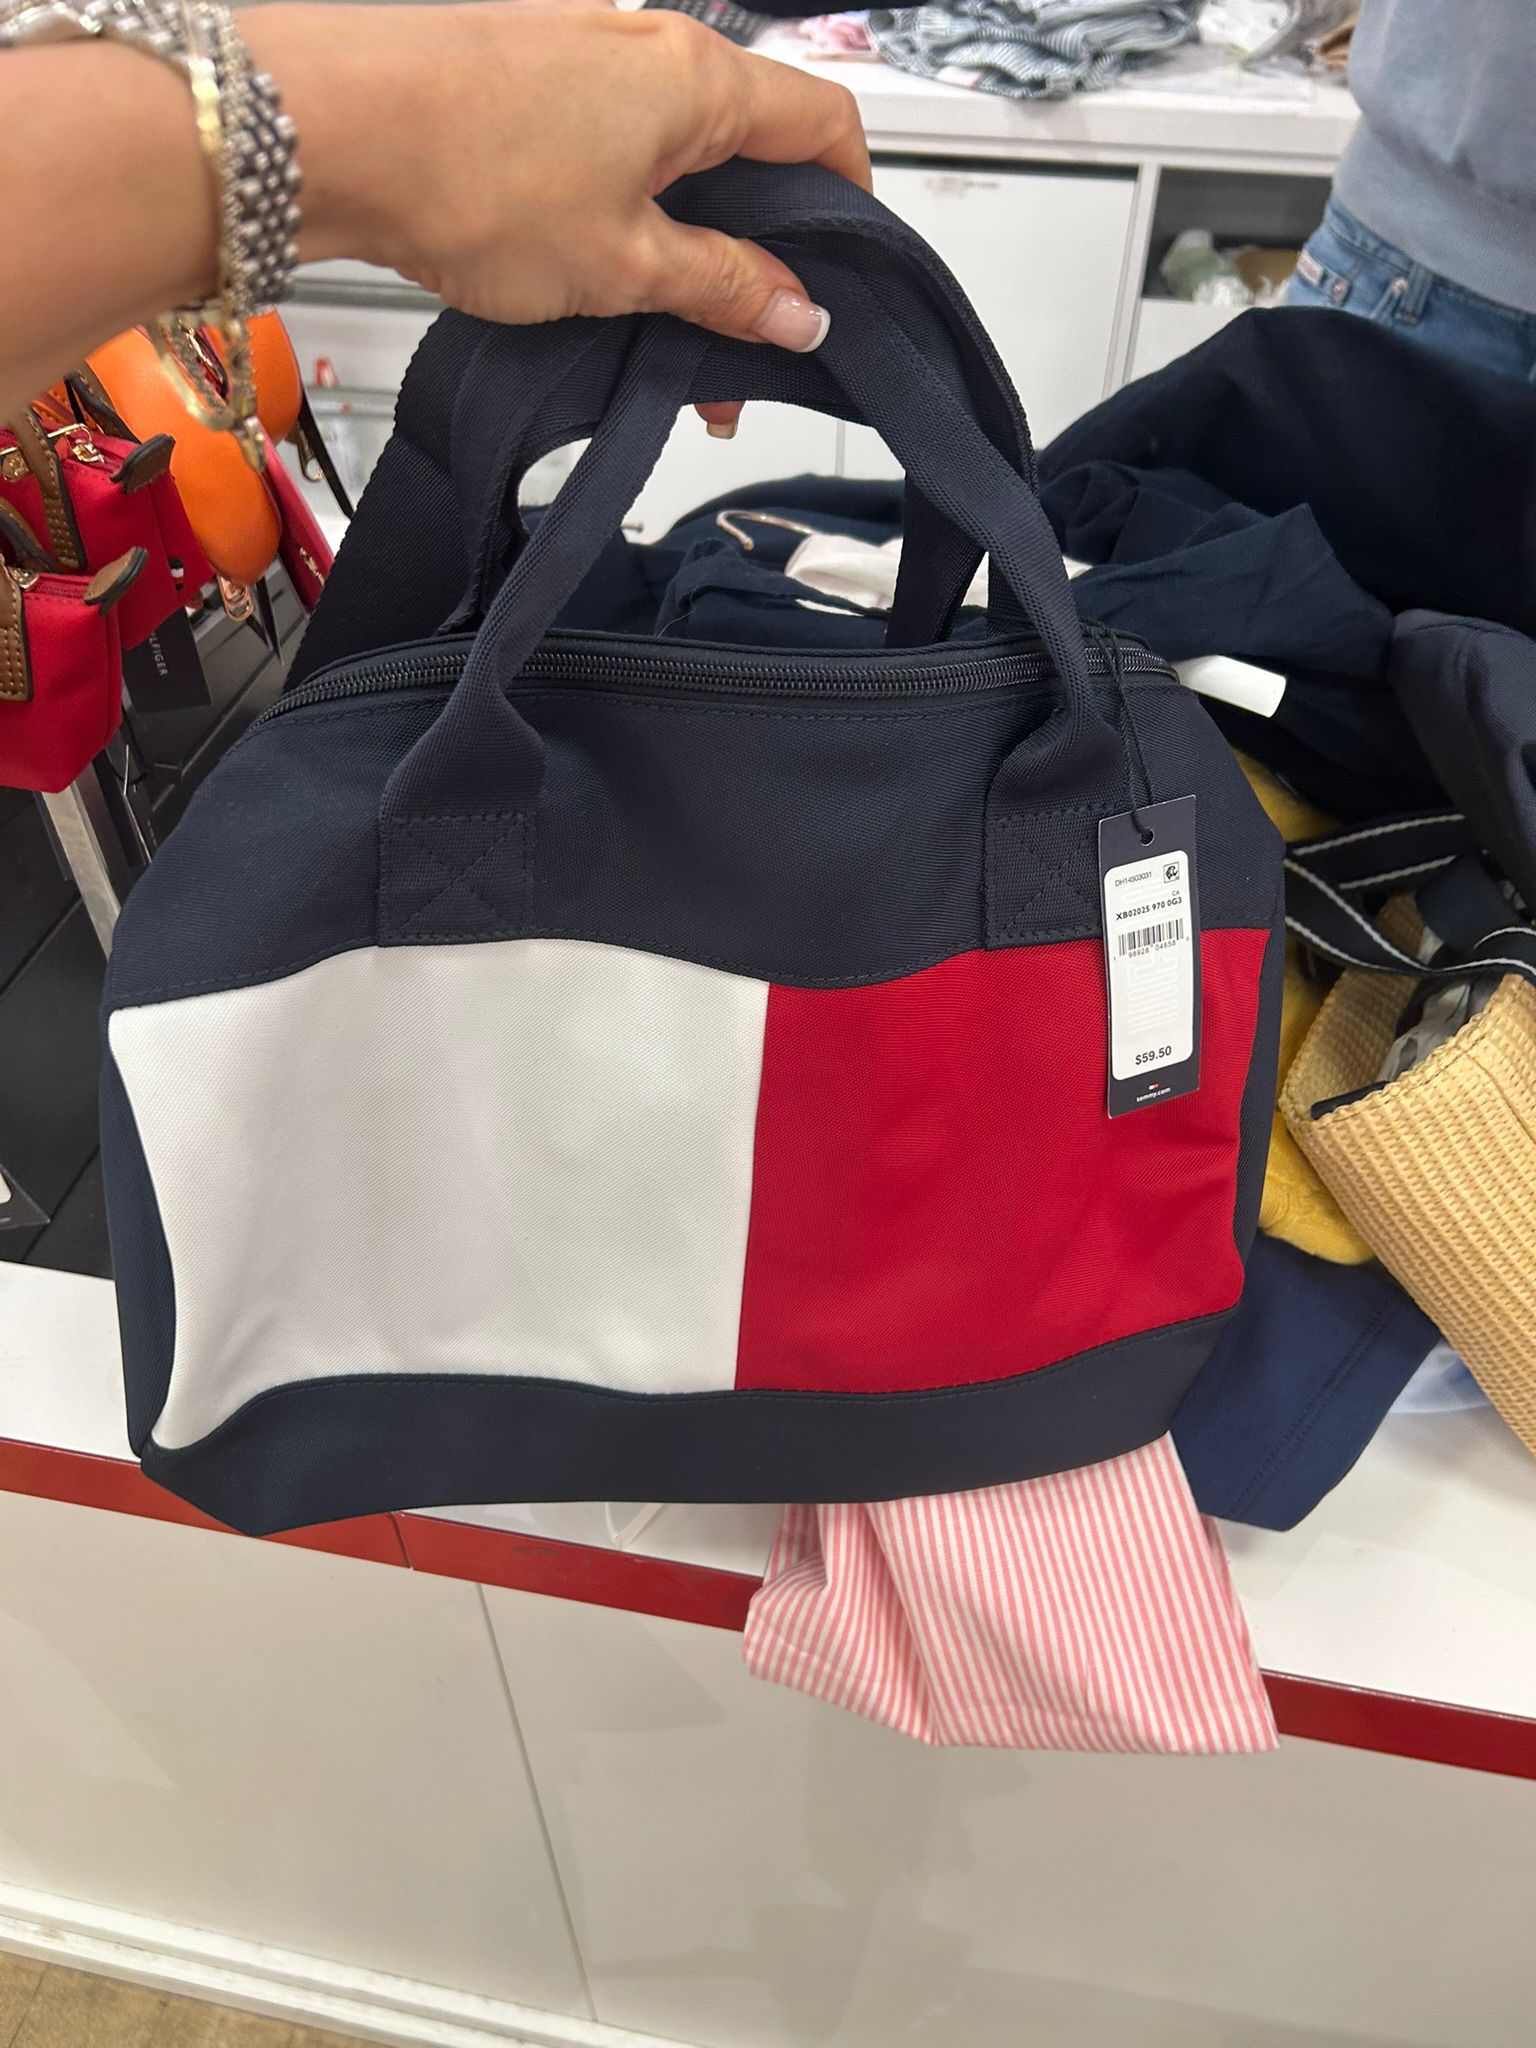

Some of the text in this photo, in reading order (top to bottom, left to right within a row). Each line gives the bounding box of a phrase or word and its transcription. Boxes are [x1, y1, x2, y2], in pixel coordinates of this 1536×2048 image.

[1116, 905, 1150, 921] XB02025
[1152, 901, 1166, 911] 970
[1135, 1045, 1172, 1065] $59.50
